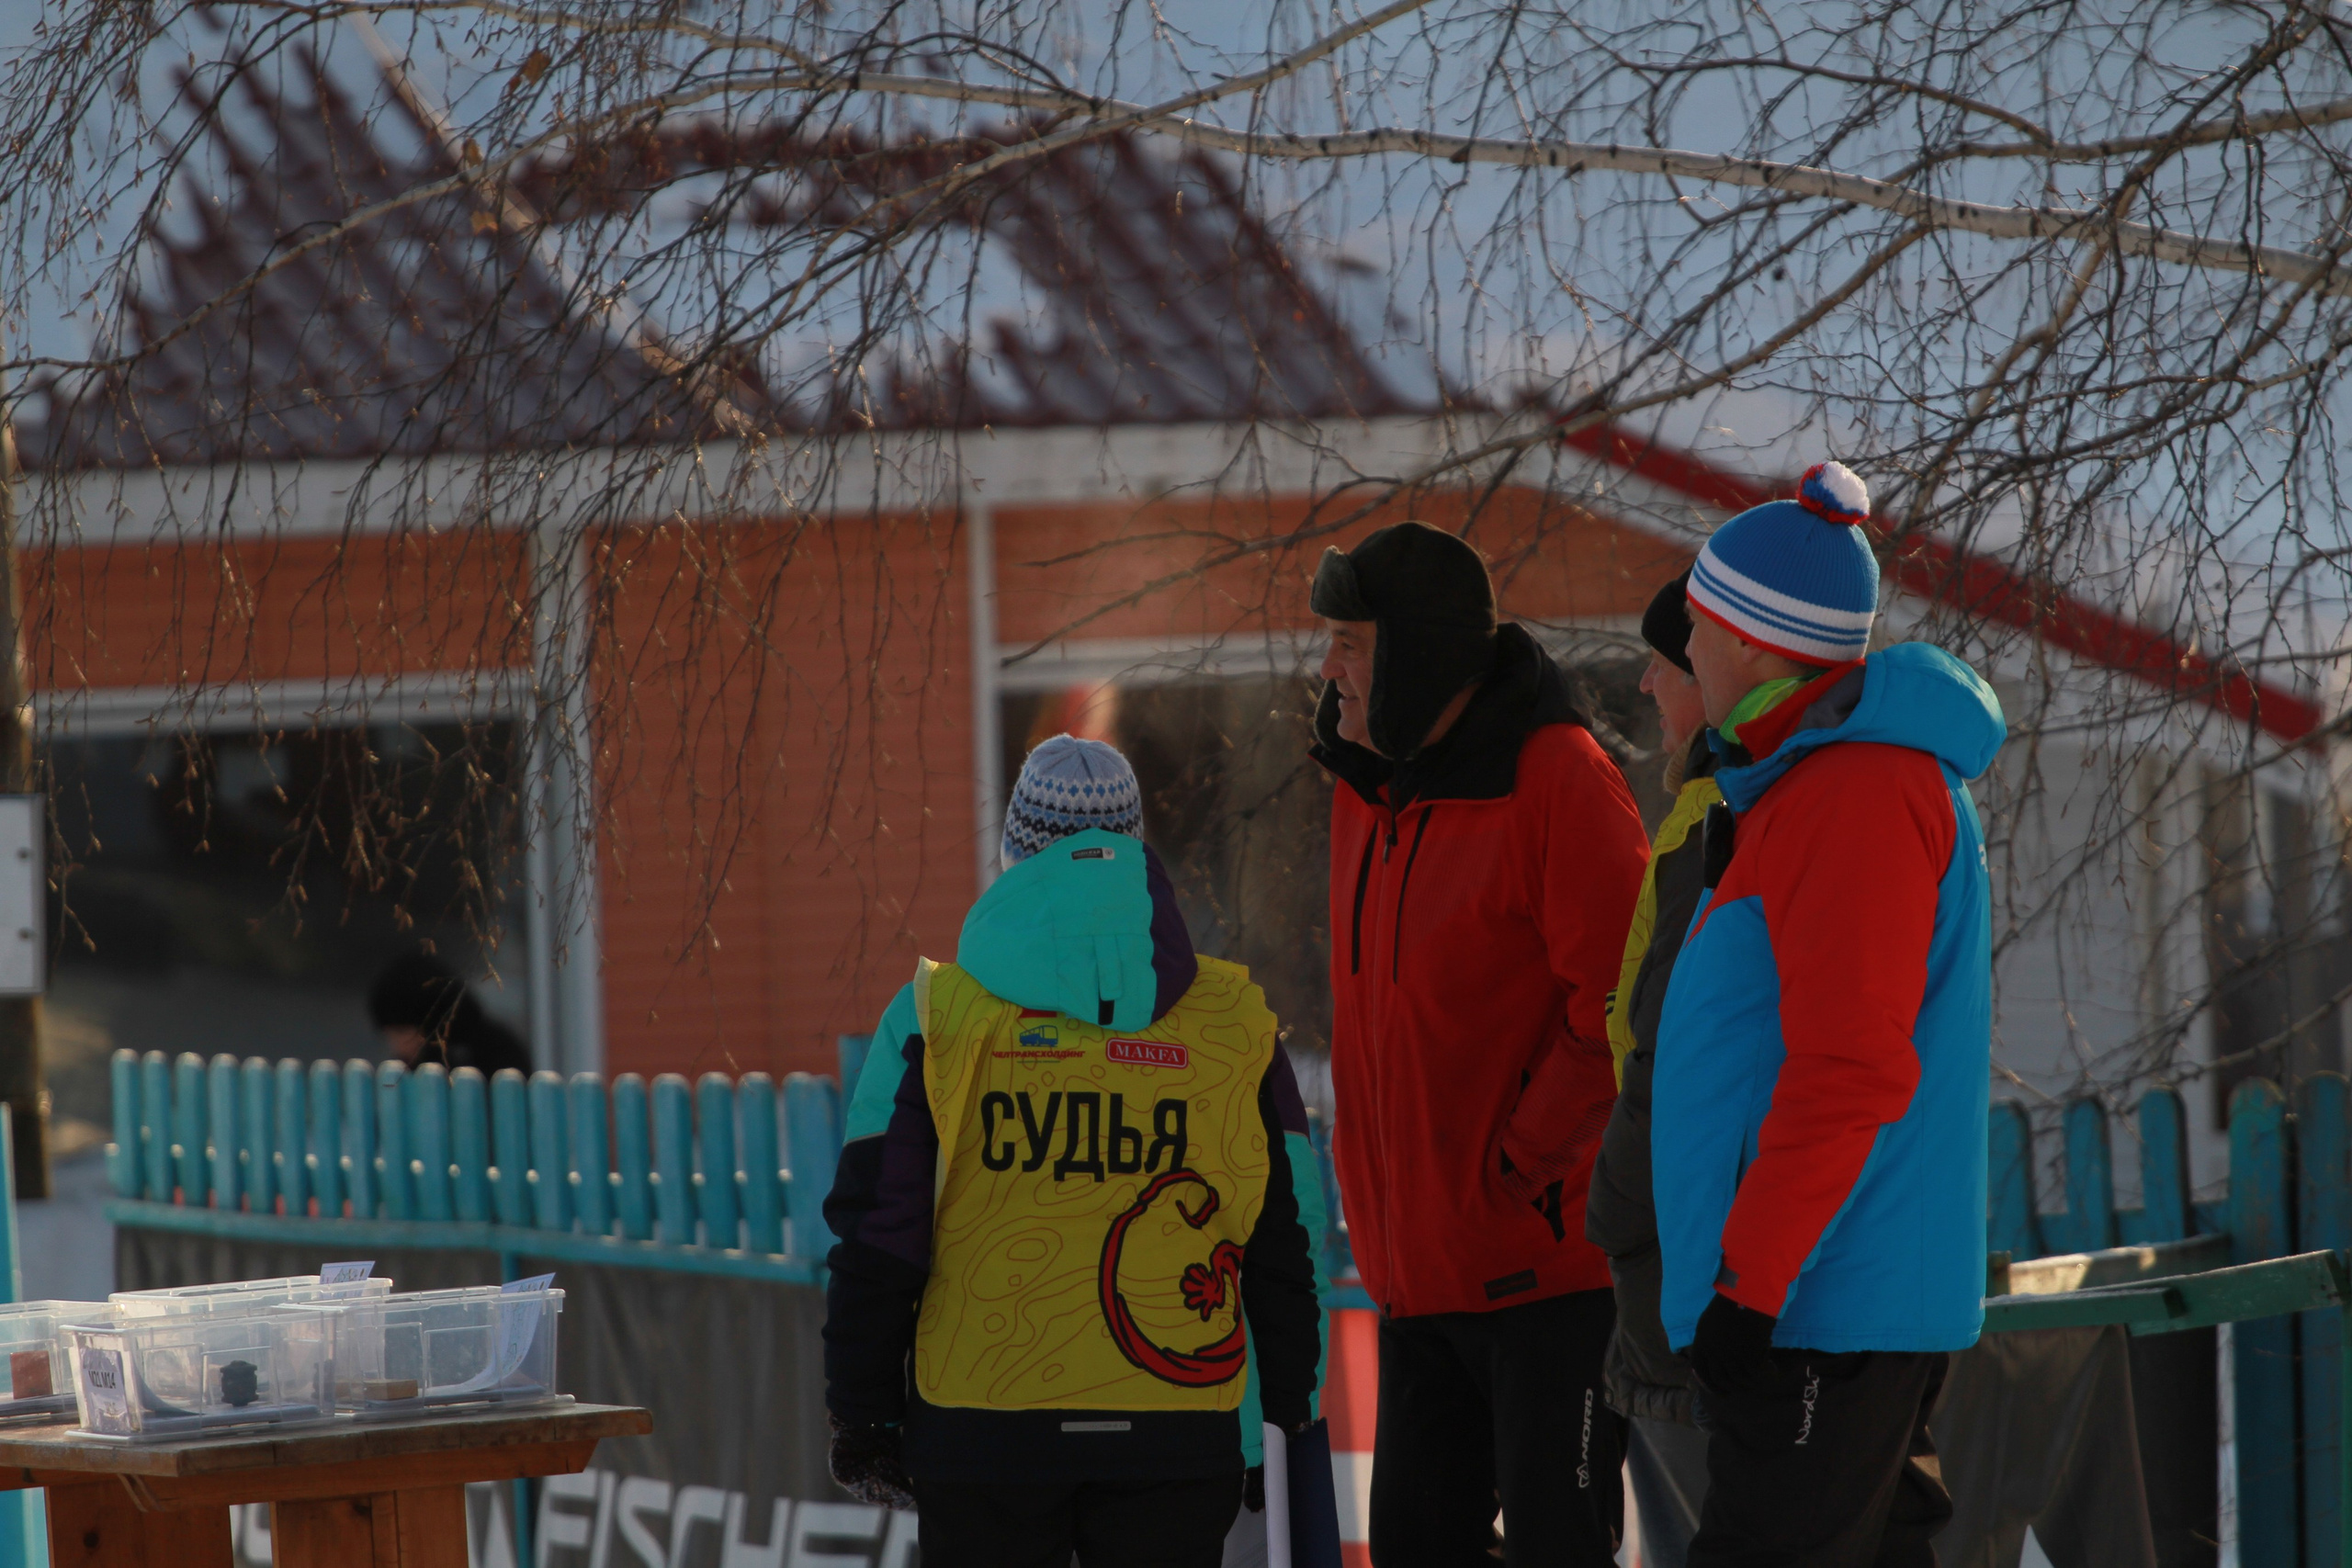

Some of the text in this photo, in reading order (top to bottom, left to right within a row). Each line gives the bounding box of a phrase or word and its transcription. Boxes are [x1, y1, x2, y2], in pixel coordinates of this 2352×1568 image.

[1114, 1044, 1181, 1063] MAKFA
[981, 1090, 1187, 1182] СУДЬЯ
[1581, 1388, 1593, 1461] NORD
